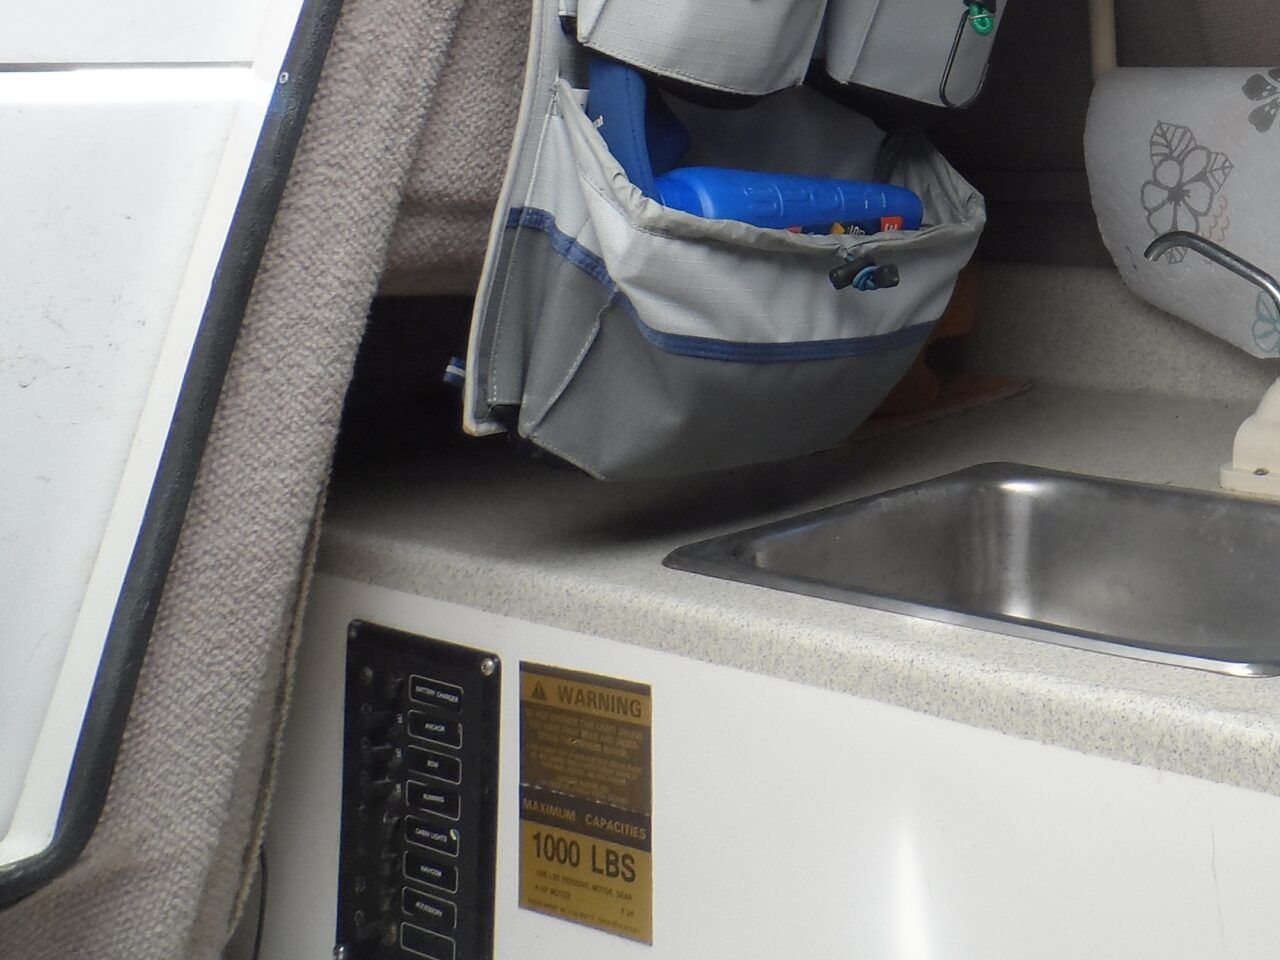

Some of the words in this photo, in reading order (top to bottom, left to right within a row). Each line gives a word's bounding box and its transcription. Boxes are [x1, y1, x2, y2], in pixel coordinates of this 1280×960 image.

[436, 691, 459, 704] CHARGER
[557, 685, 641, 717] WARNING
[523, 798, 576, 821] MAXIMUM
[585, 814, 646, 840] CAPACITIES
[532, 832, 580, 868] 1000
[591, 847, 637, 883] LBS
